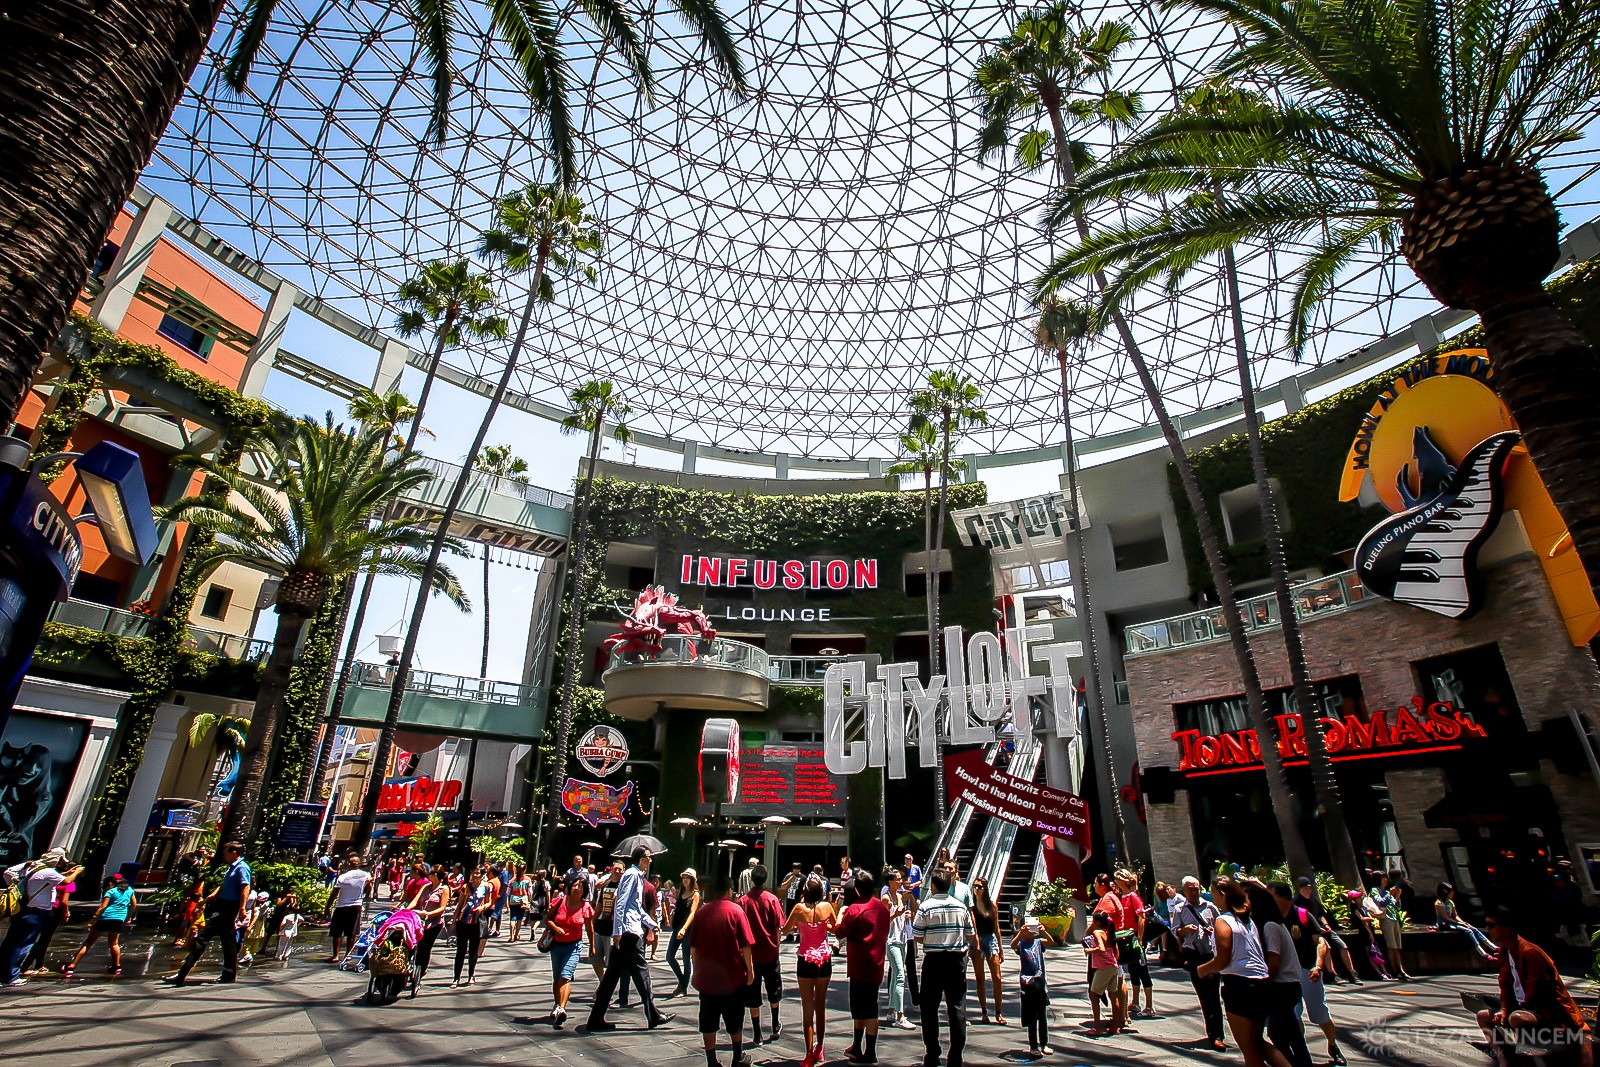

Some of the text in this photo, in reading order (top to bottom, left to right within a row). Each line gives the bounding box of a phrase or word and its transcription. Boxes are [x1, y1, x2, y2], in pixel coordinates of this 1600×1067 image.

[1352, 354, 1497, 471] HOWL AT THE MOO
[1363, 502, 1445, 571] DUELING PIANO BAR
[681, 554, 878, 589] INFUSION
[726, 605, 831, 622] LOUNGE
[1273, 696, 1463, 757] ROMA'S
[579, 748, 604, 757] BUBBA
[605, 749, 627, 759] GUMP
[955, 766, 980, 787] Howl
[979, 782, 990, 792] at
[990, 785, 1007, 800] the
[1006, 793, 1036, 811] Moon
[1039, 804, 1064, 819] Dueling
[962, 788, 1074, 836] Infusion Lounge Dance Club
[990, 770, 1008, 785] Jon
[1041, 790, 1068, 806] Comedy
[1069, 797, 1085, 808] Club
